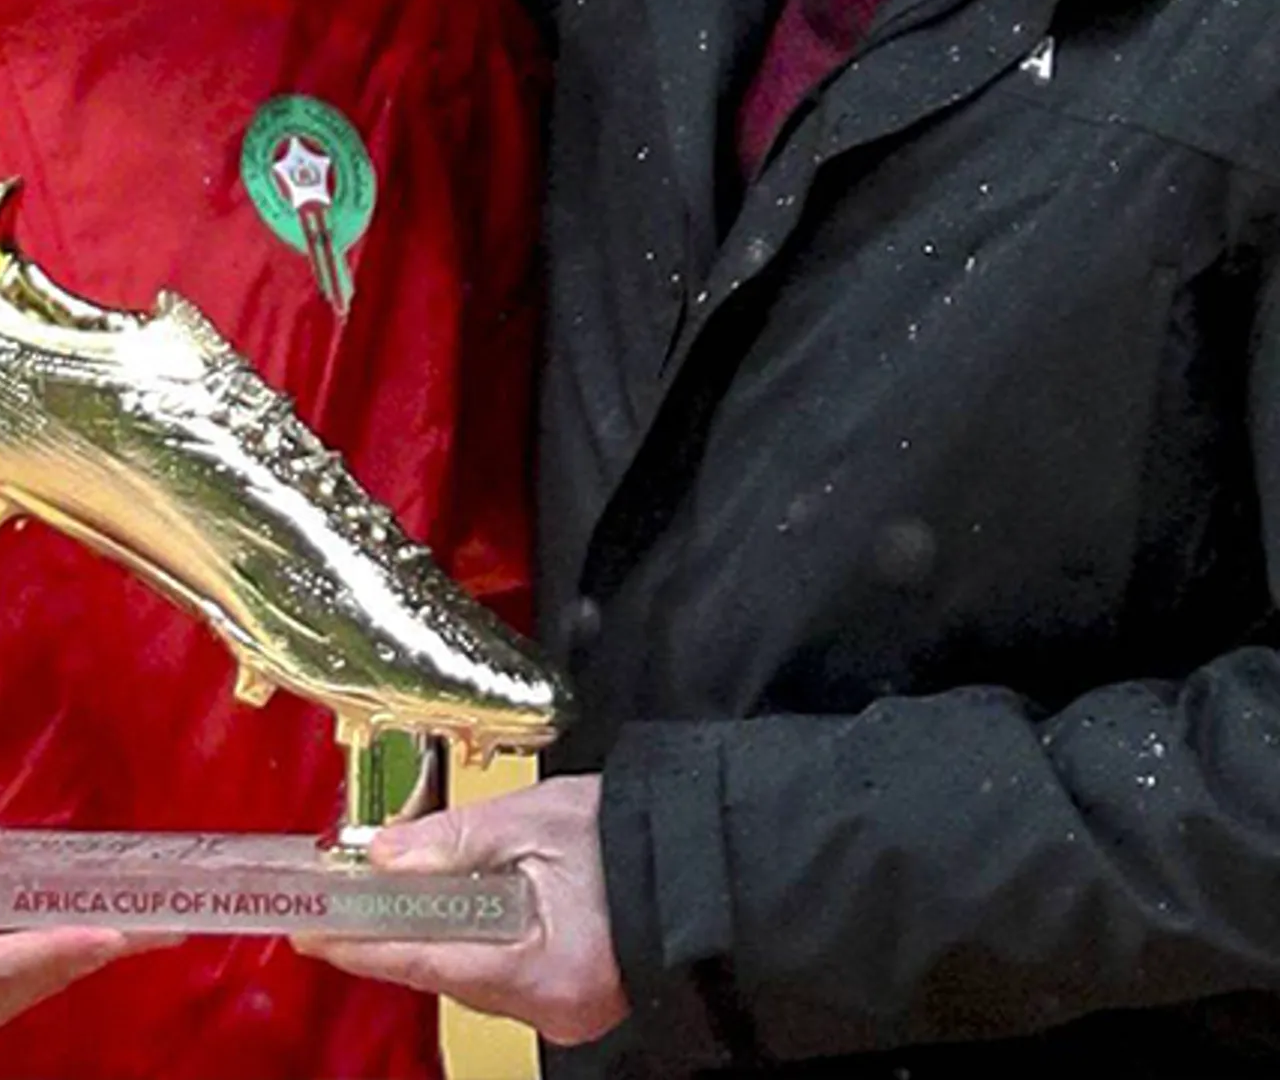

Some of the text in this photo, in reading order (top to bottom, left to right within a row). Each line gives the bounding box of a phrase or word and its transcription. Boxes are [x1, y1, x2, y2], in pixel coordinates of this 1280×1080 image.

[12, 889, 108, 914] AFRICA
[112, 891, 165, 914] CUP
[169, 891, 207, 914] OF
[212, 892, 329, 916] NATIONS
[332, 893, 470, 918] MOROCCO
[475, 895, 504, 918] 25
